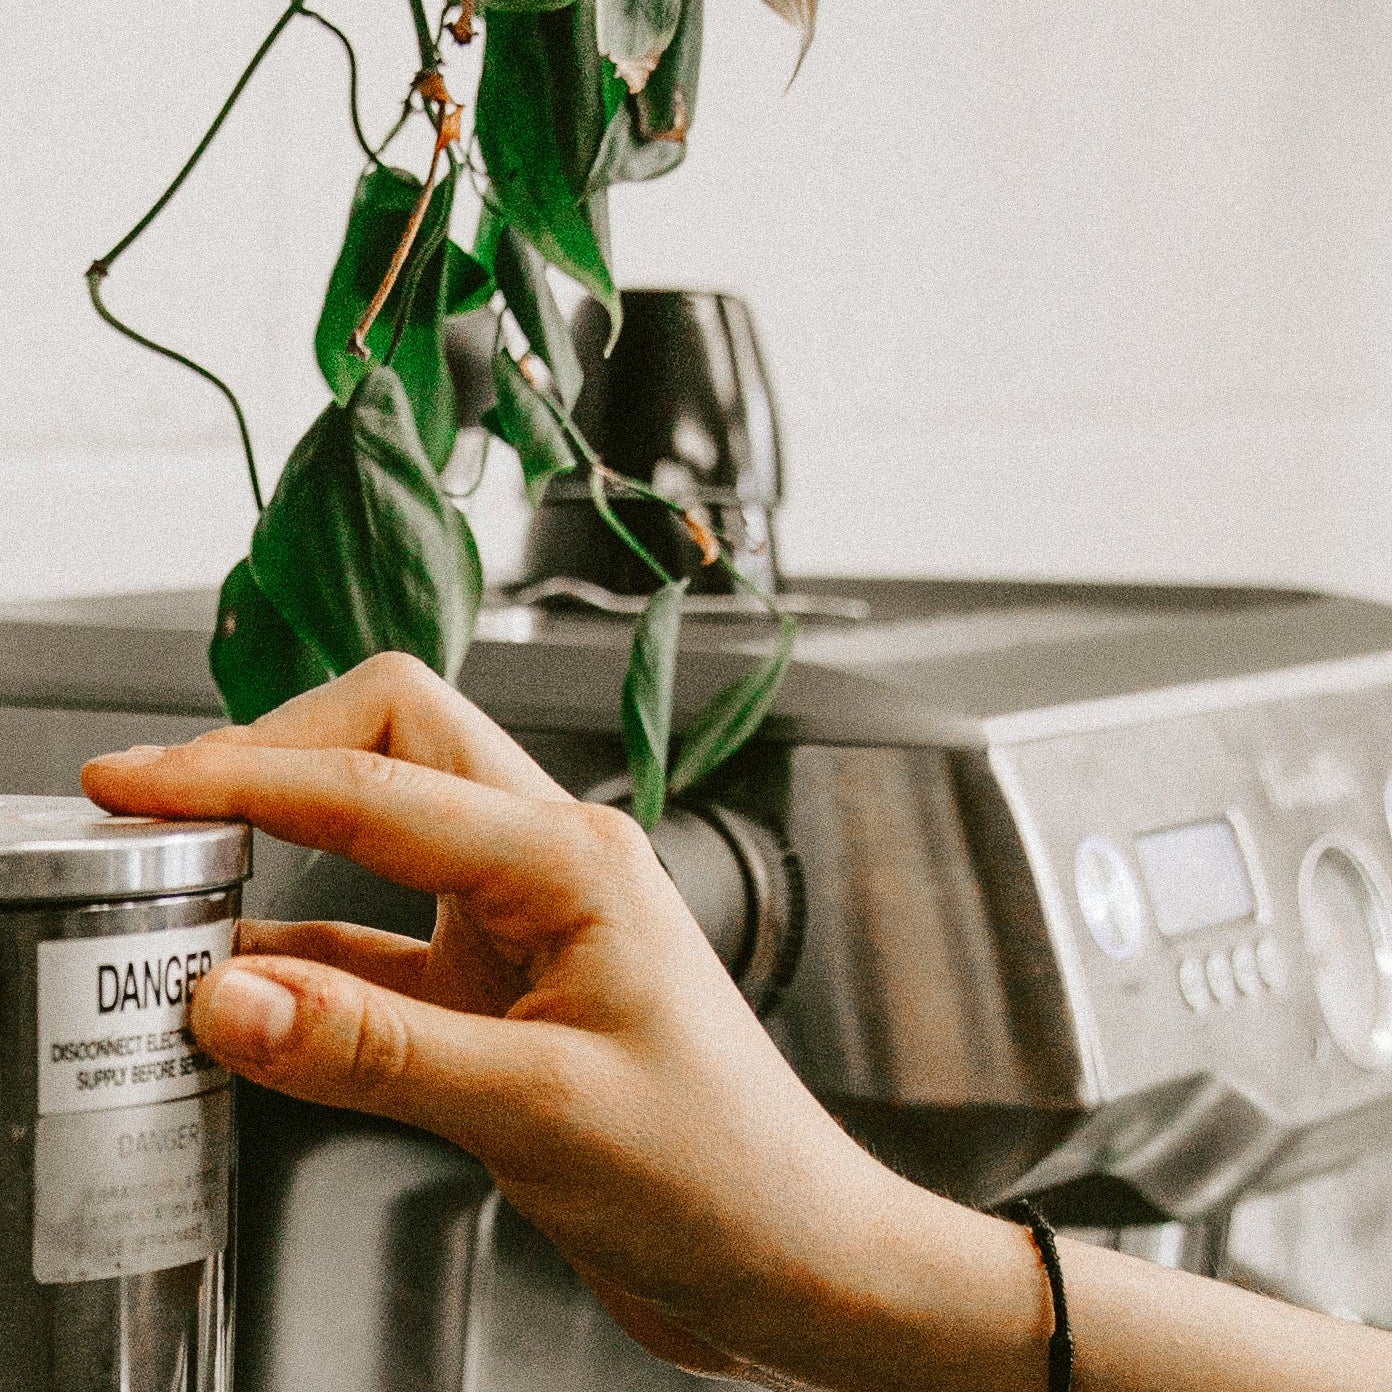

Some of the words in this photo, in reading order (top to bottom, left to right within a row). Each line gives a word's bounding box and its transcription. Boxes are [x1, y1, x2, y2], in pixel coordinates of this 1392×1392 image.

[51, 1035, 143, 1063] DISCONNECT
[76, 1067, 128, 1091] SUPPLY
[131, 1059, 176, 1084] BEFORE
[118, 1123, 201, 1158] DANGER
